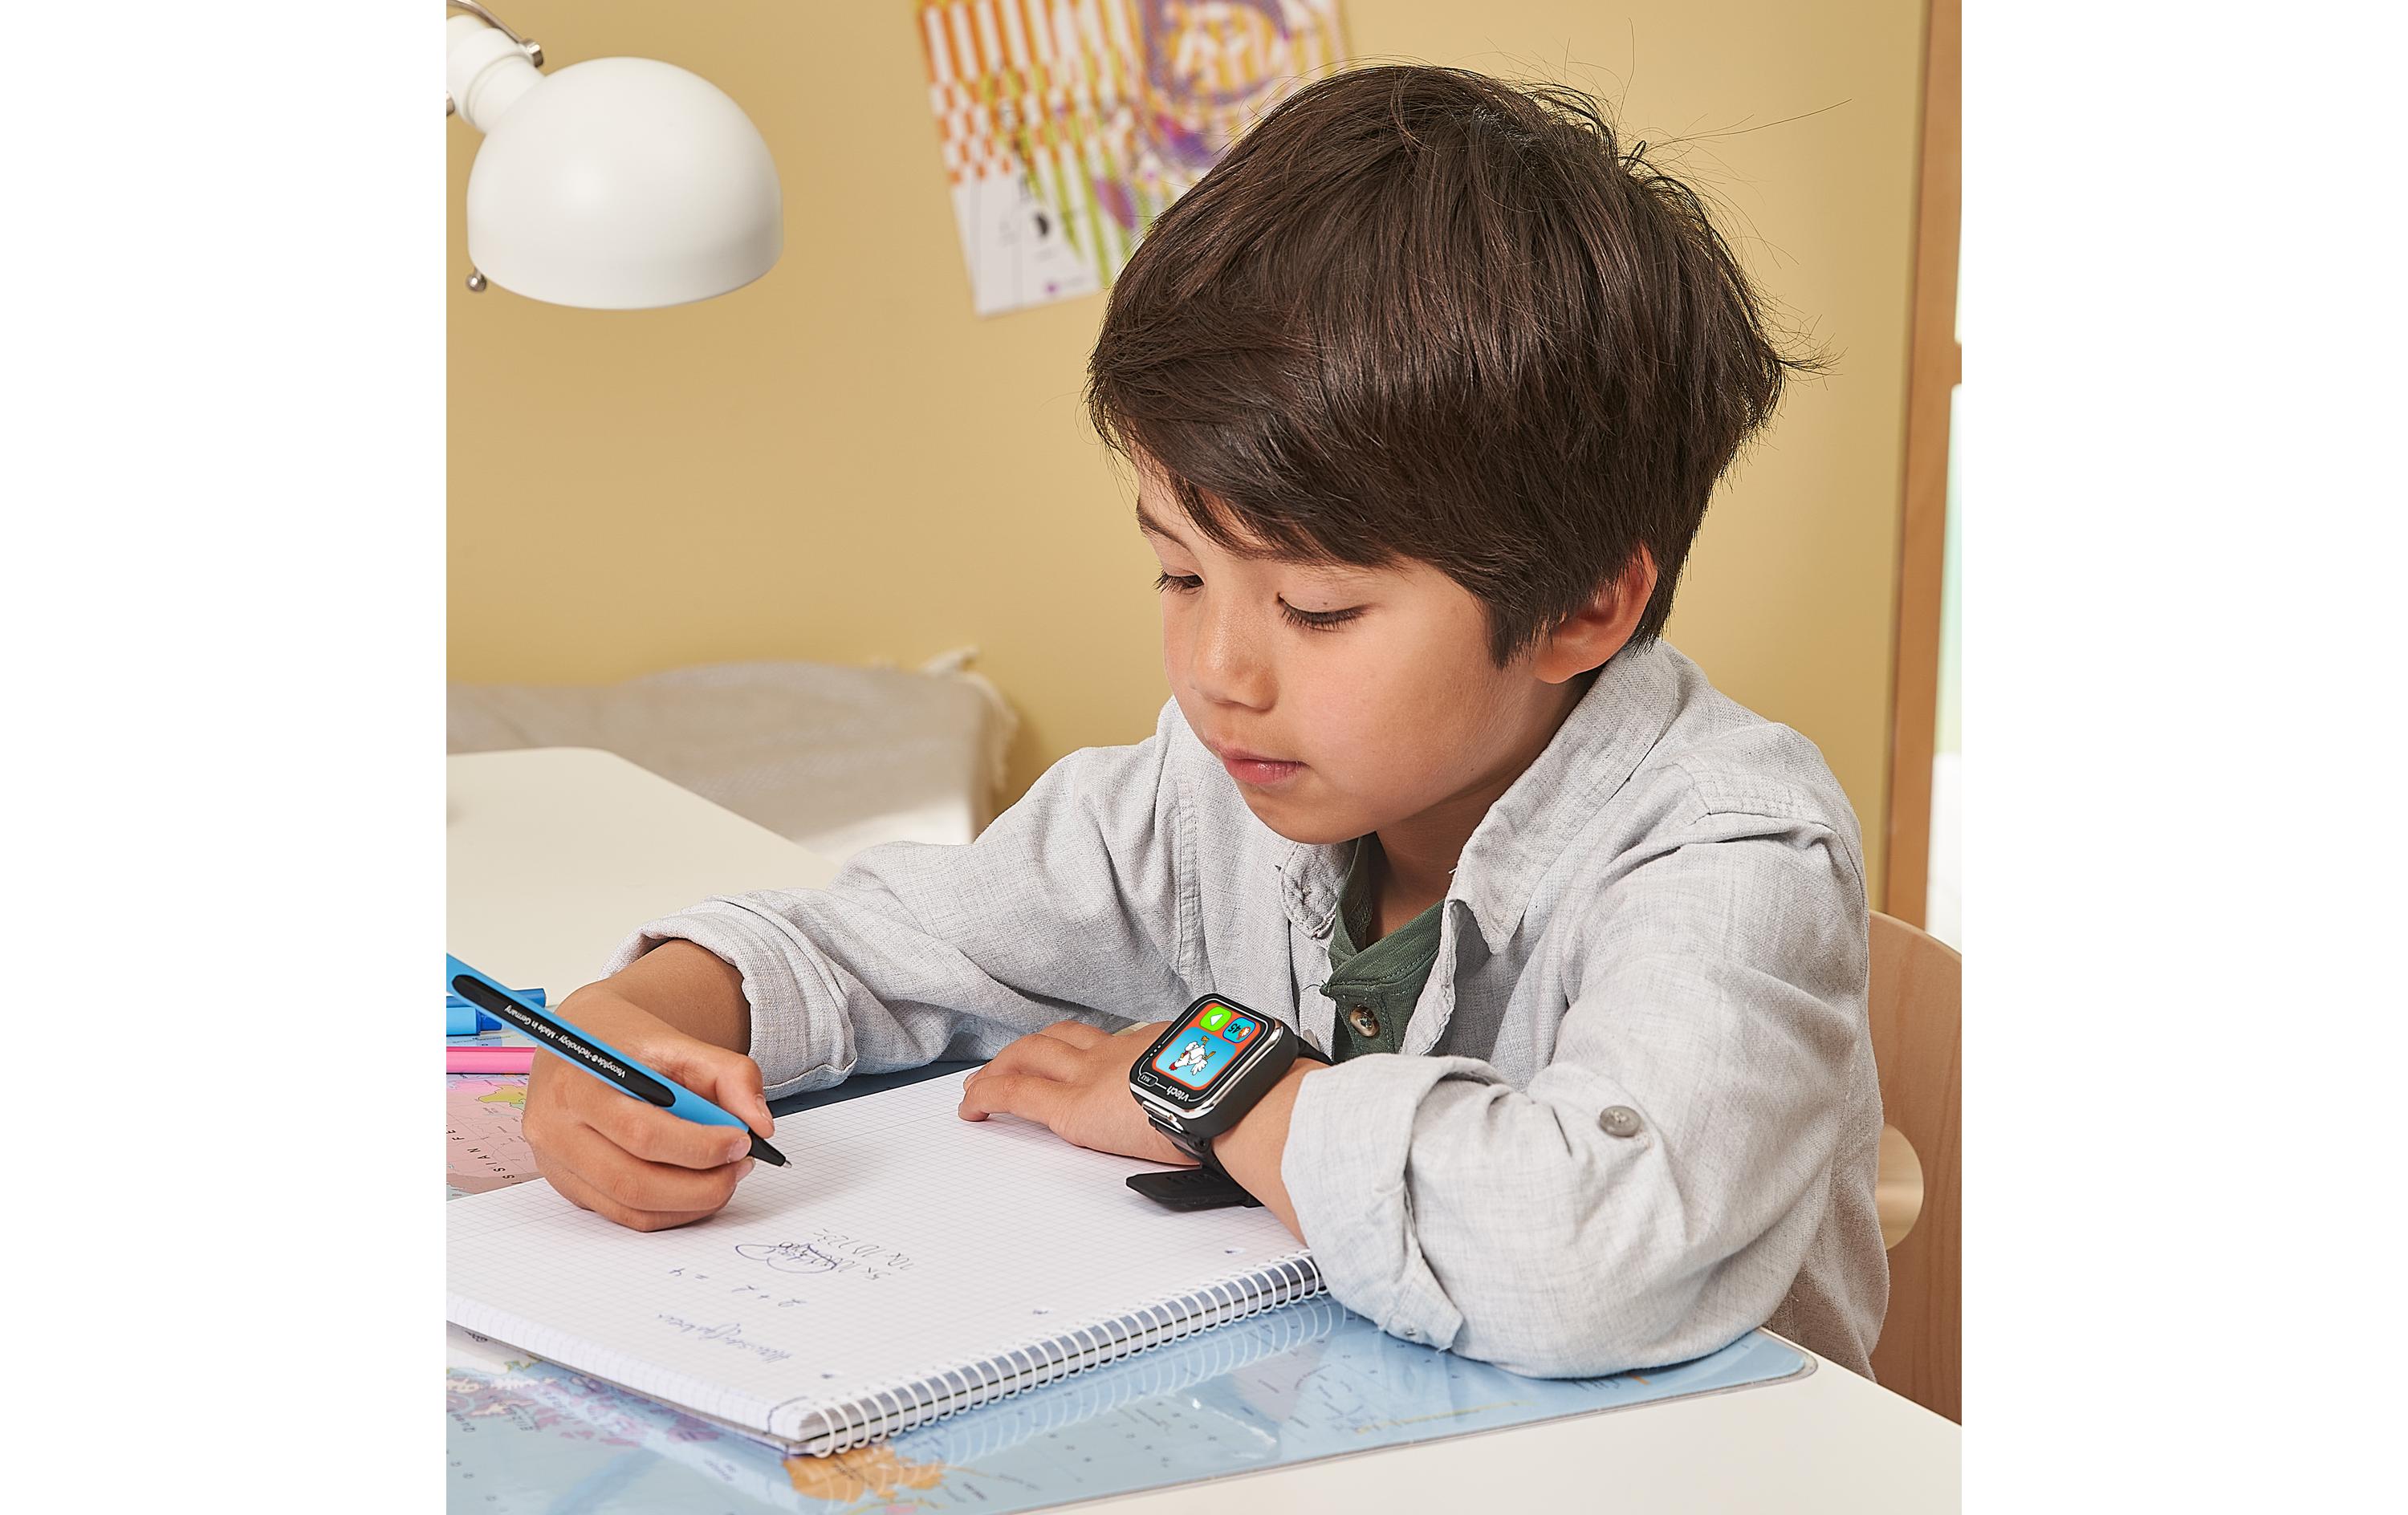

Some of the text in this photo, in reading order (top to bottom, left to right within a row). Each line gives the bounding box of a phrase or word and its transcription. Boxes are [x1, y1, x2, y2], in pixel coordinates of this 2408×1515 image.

[504, 1005, 532, 1026] Germany
[531, 1020, 539, 1029] in
[538, 1023, 556, 1039] Made
[1228, 1023, 1242, 1034] 45
